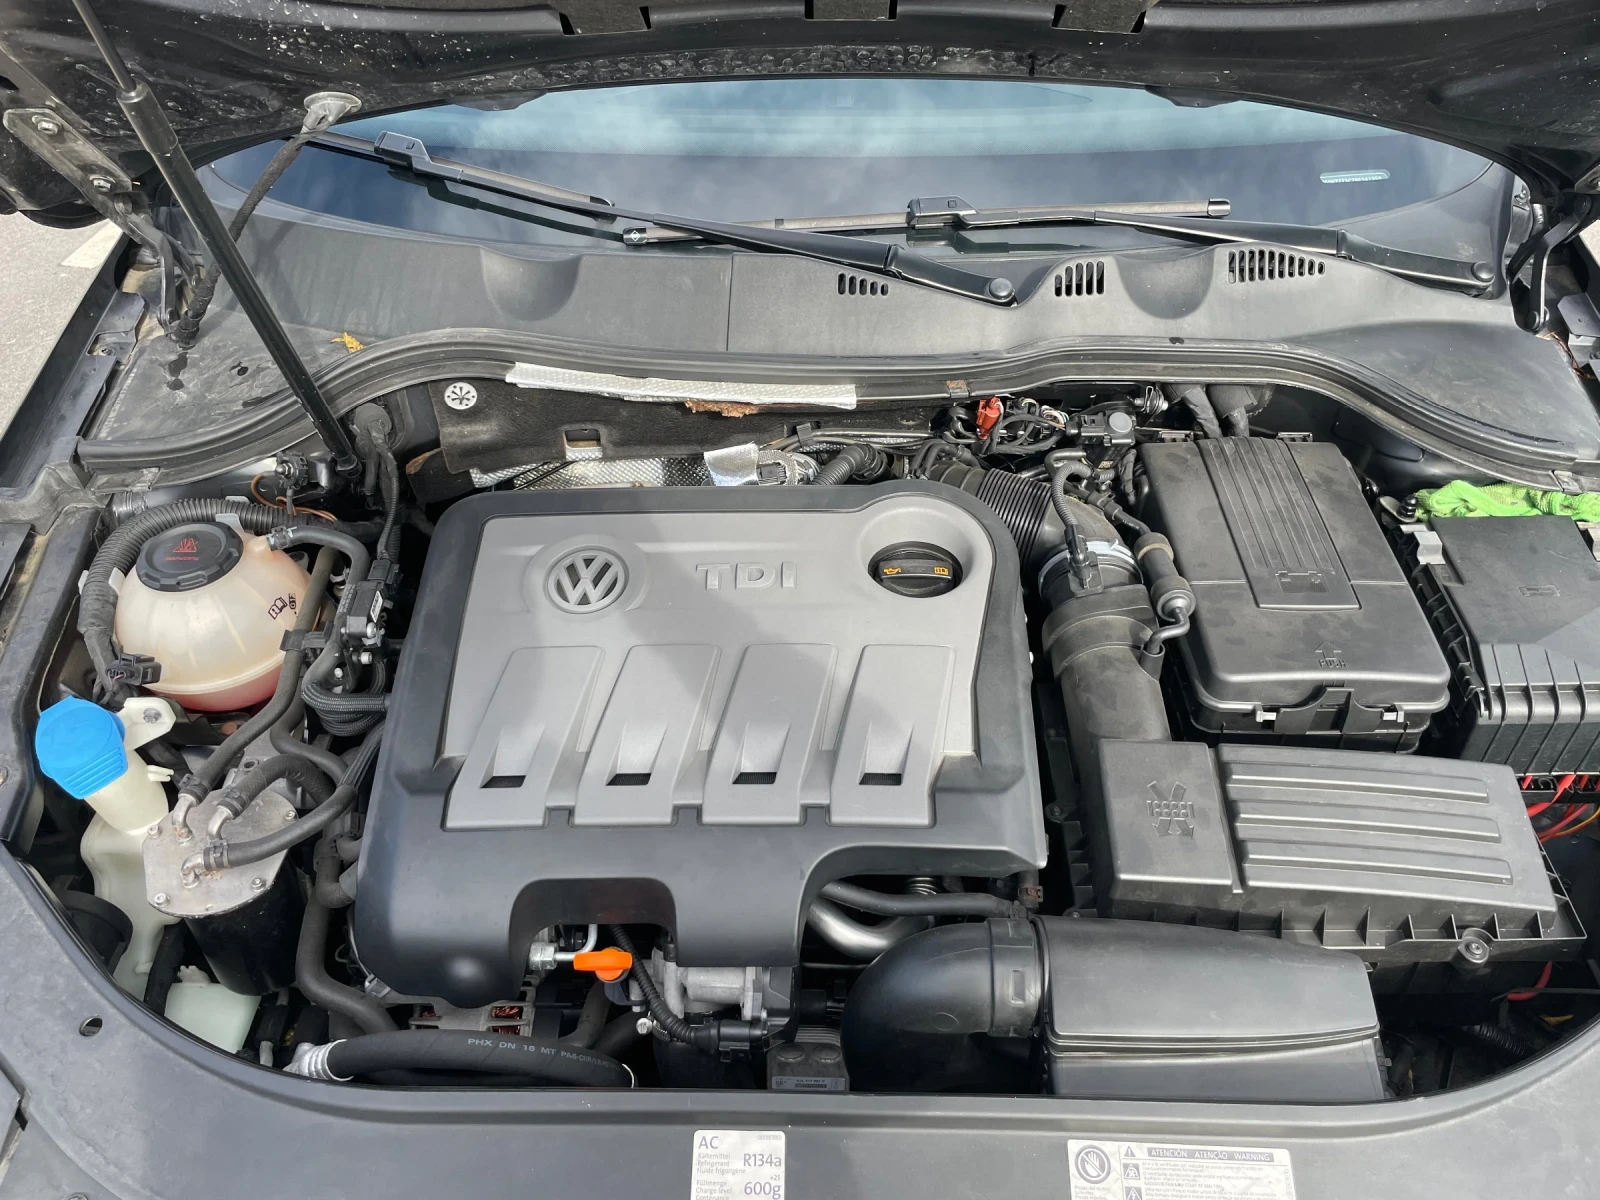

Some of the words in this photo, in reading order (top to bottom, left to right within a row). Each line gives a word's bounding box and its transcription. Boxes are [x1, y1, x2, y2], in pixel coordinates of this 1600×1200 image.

[696, 561, 797, 591] TDI
[467, 1038, 493, 1047] PHX
[499, 1041, 516, 1050] DN
[523, 1044, 536, 1052] 16
[540, 1046, 557, 1056] MT
[698, 1136, 719, 1149] AC
[743, 1153, 782, 1167] R134a
[1151, 1148, 1188, 1158] ATENCIÓN
[1233, 1152, 1270, 1161] WARNING
[744, 1181, 781, 1200] 600g
